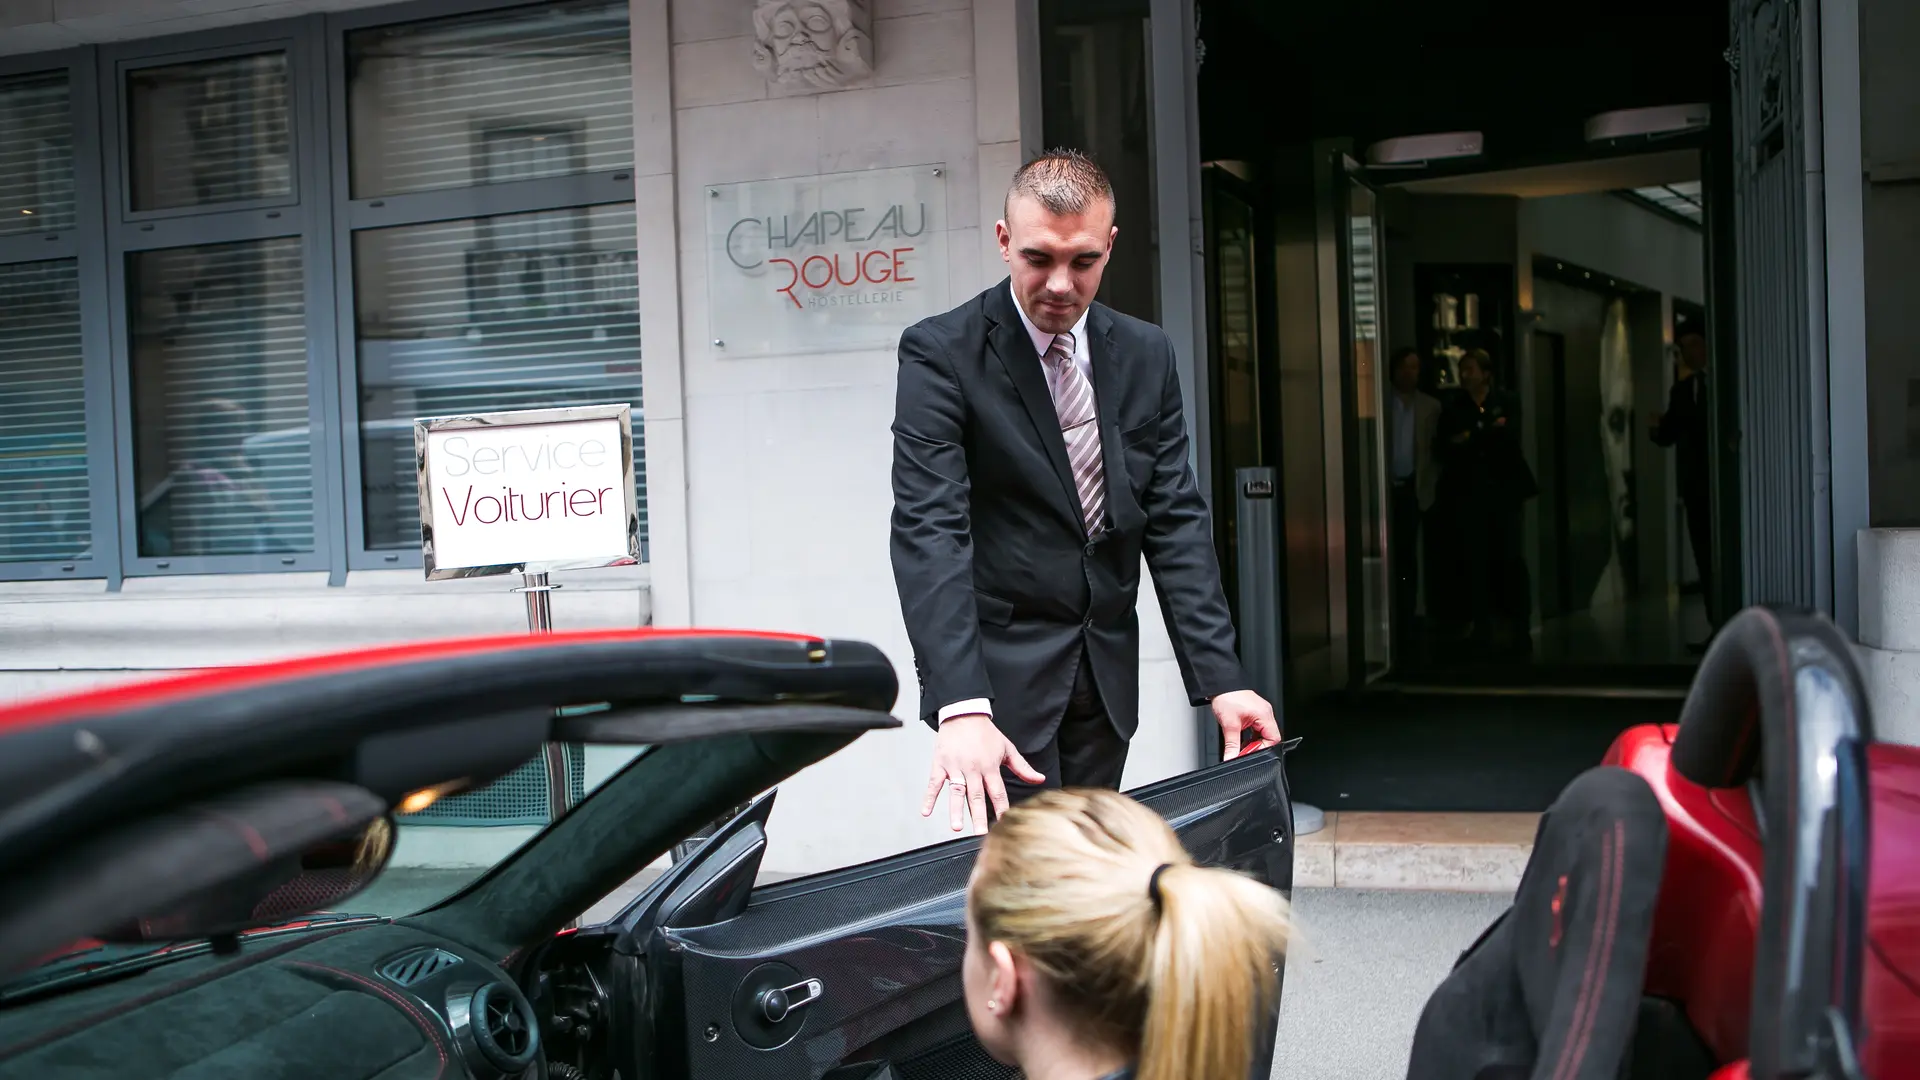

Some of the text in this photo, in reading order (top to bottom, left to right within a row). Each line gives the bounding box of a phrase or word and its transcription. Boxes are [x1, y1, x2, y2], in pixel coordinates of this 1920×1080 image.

[726, 202, 926, 270] CHAPEAU
[768, 247, 915, 309] ROUGE
[808, 290, 904, 309] HOSTELLERIE
[443, 434, 606, 477] Service
[442, 481, 614, 526] Voiturier
